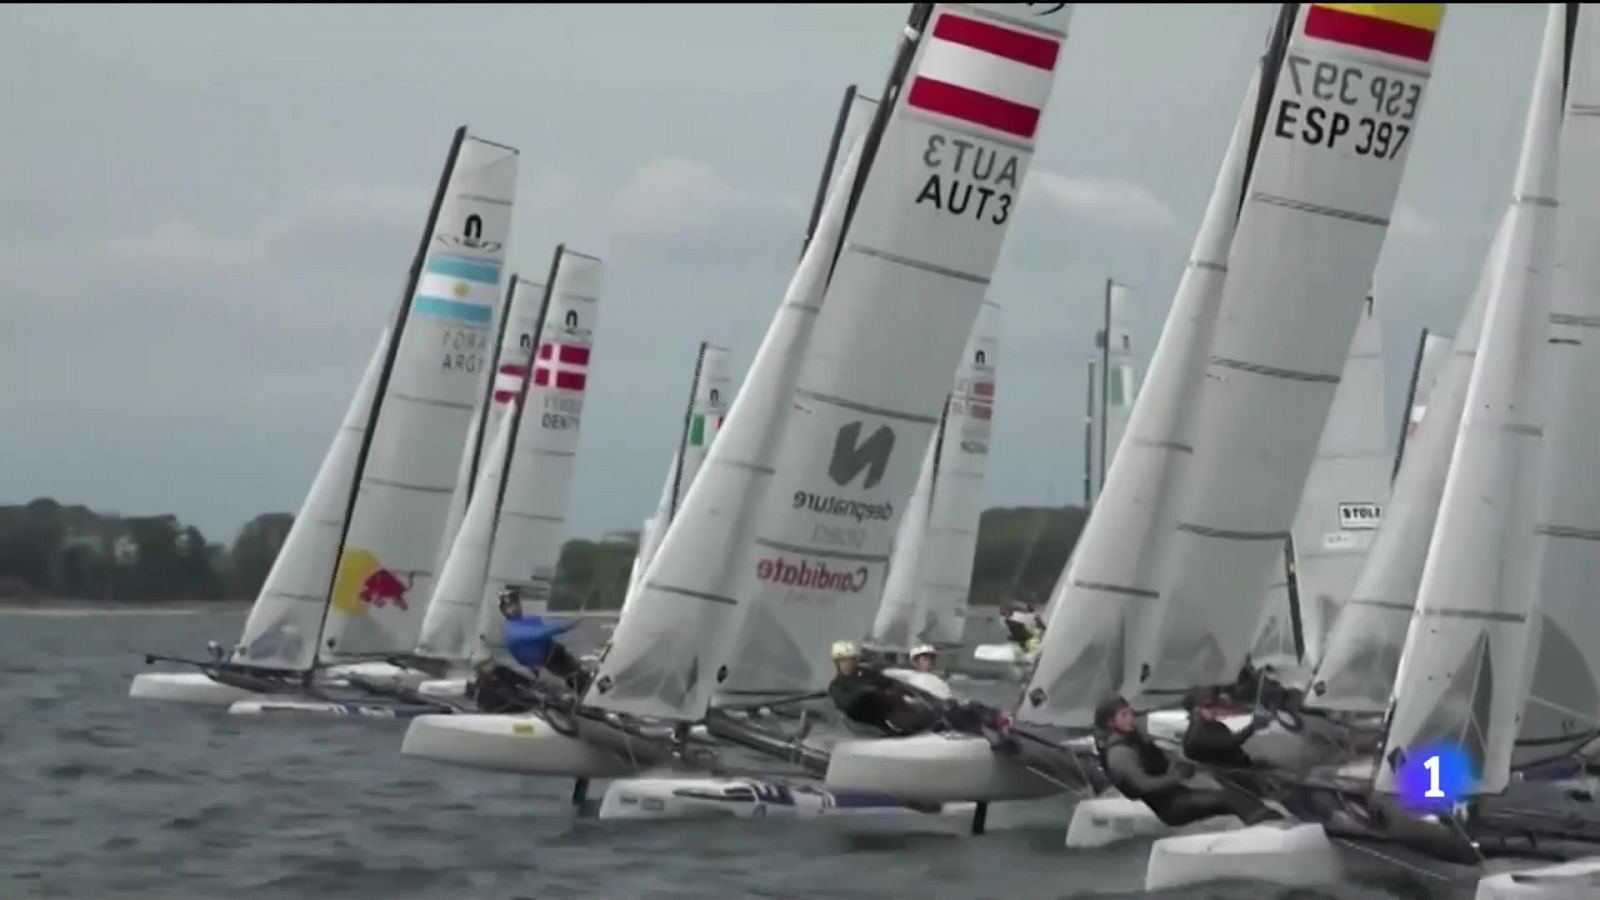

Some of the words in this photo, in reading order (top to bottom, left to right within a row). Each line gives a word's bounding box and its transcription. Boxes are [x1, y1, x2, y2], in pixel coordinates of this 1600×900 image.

[1275, 99, 1351, 149] ESP
[1354, 117, 1411, 161] 397
[915, 173, 1012, 226] AUT3
